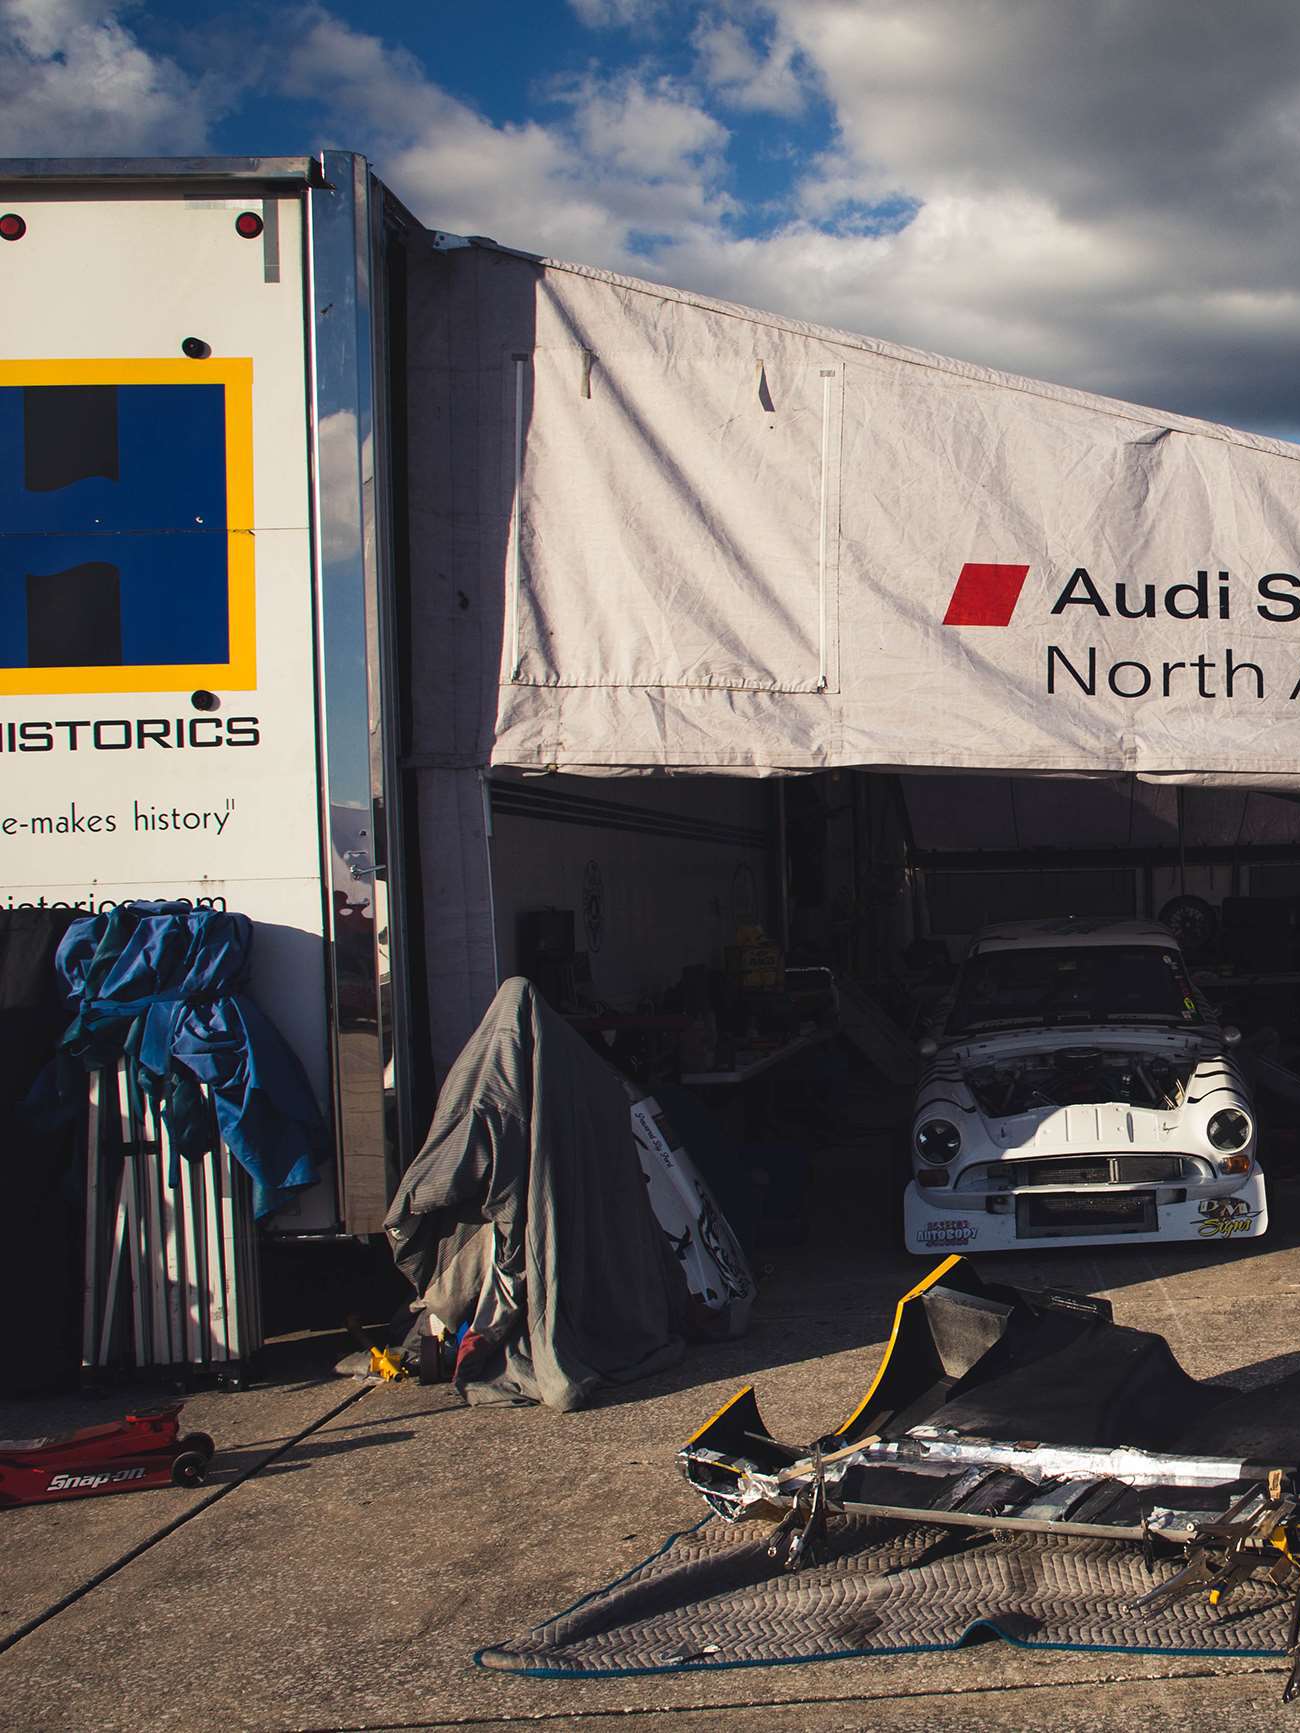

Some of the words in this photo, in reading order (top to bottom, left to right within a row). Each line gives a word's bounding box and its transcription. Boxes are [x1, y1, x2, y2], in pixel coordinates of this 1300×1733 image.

[1051, 567, 1230, 619] Audi
[1046, 645, 1264, 699] North
[47, 1467, 147, 1491] Snap-on
